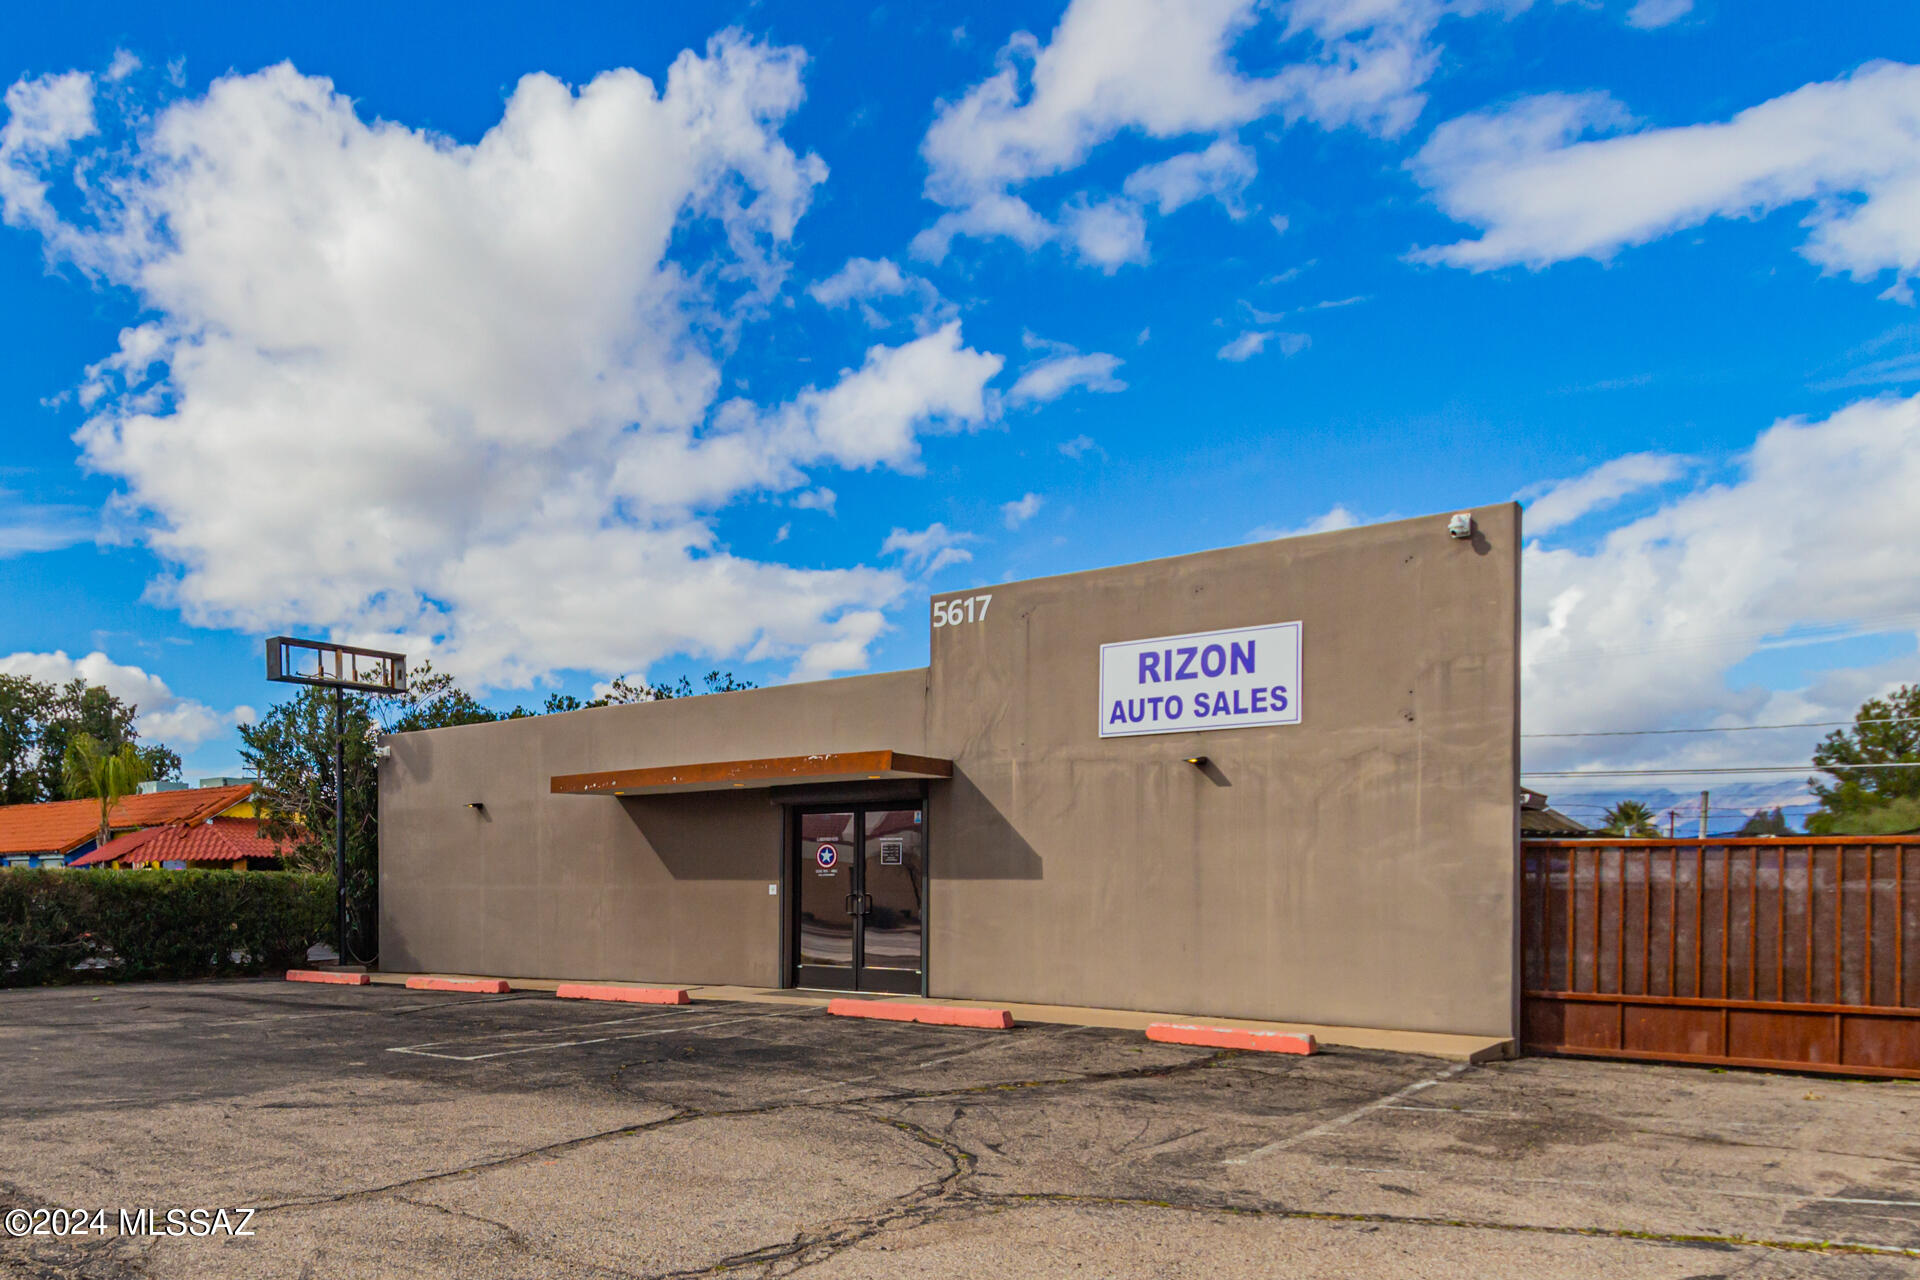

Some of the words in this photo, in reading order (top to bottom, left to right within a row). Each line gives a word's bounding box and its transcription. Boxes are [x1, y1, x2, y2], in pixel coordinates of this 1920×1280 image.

[933, 594, 992, 627] 5617
[1138, 640, 1256, 684] RIZON
[1109, 695, 1184, 724] AUTO
[1193, 685, 1288, 718] SALES
